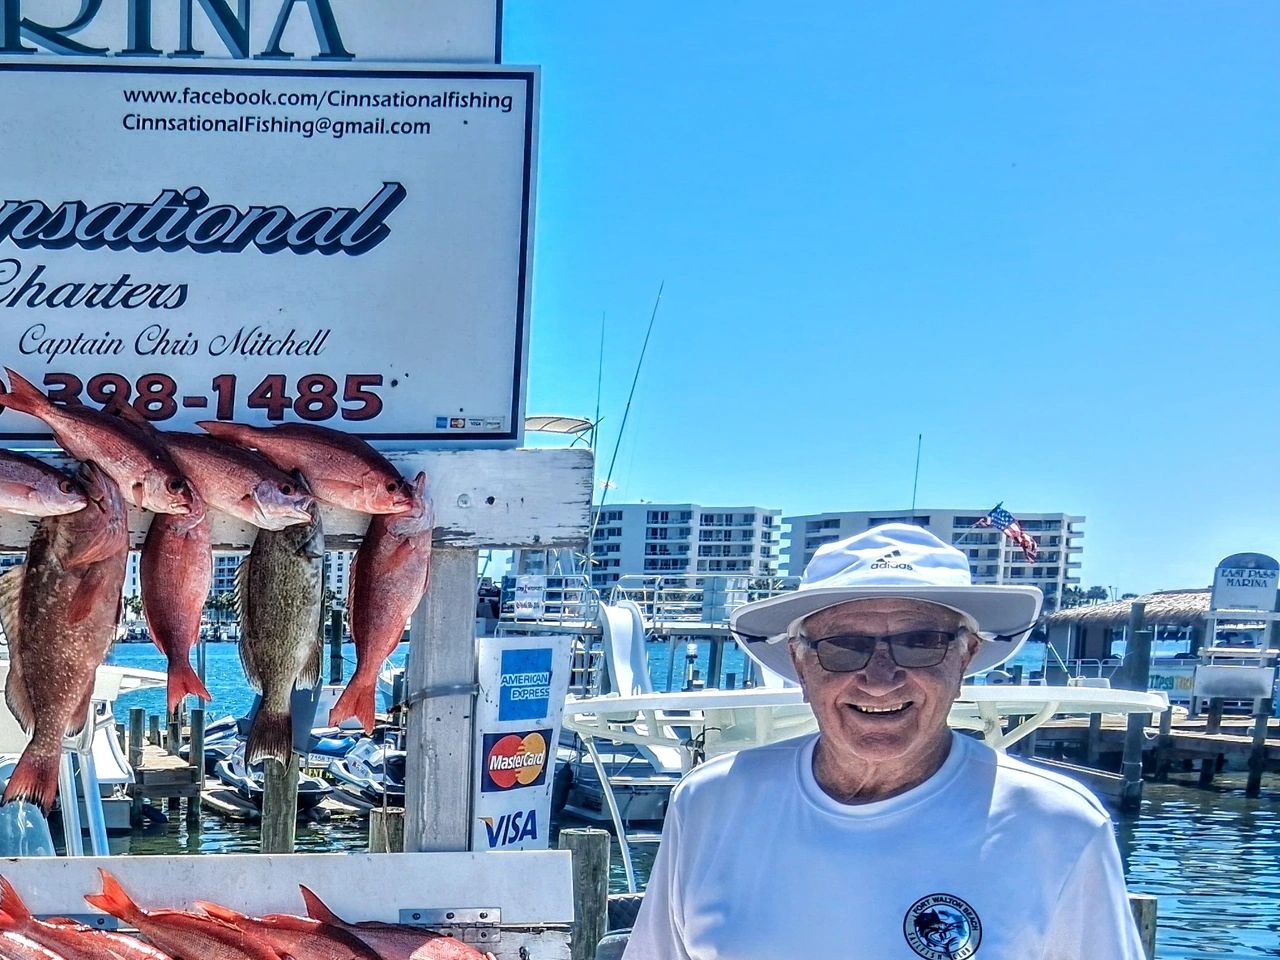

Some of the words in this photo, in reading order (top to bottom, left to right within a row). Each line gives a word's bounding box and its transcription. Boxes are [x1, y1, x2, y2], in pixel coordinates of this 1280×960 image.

[123, 87, 513, 113] www.facebook.com/Cinnsationalfishing
[122, 113, 431, 138] CinnsationalFishing@gmail.com
[18, 323, 125, 364] Captain
[133, 323, 199, 356] Chris
[207, 324, 332, 357] Mitchell
[870, 561, 913, 571] adidas
[1226, 578, 1268, 588] MARINA
[501, 672, 548, 686] AMERICAN
[512, 687, 550, 700] EXPRESS
[489, 750, 545, 771] MasterCard
[483, 809, 538, 849] VISA
[912, 898, 932, 915] FORT
[931, 896, 964, 910] WALTON
[962, 906, 979, 932] BEACH
[907, 931, 943, 960] SAILFISH
